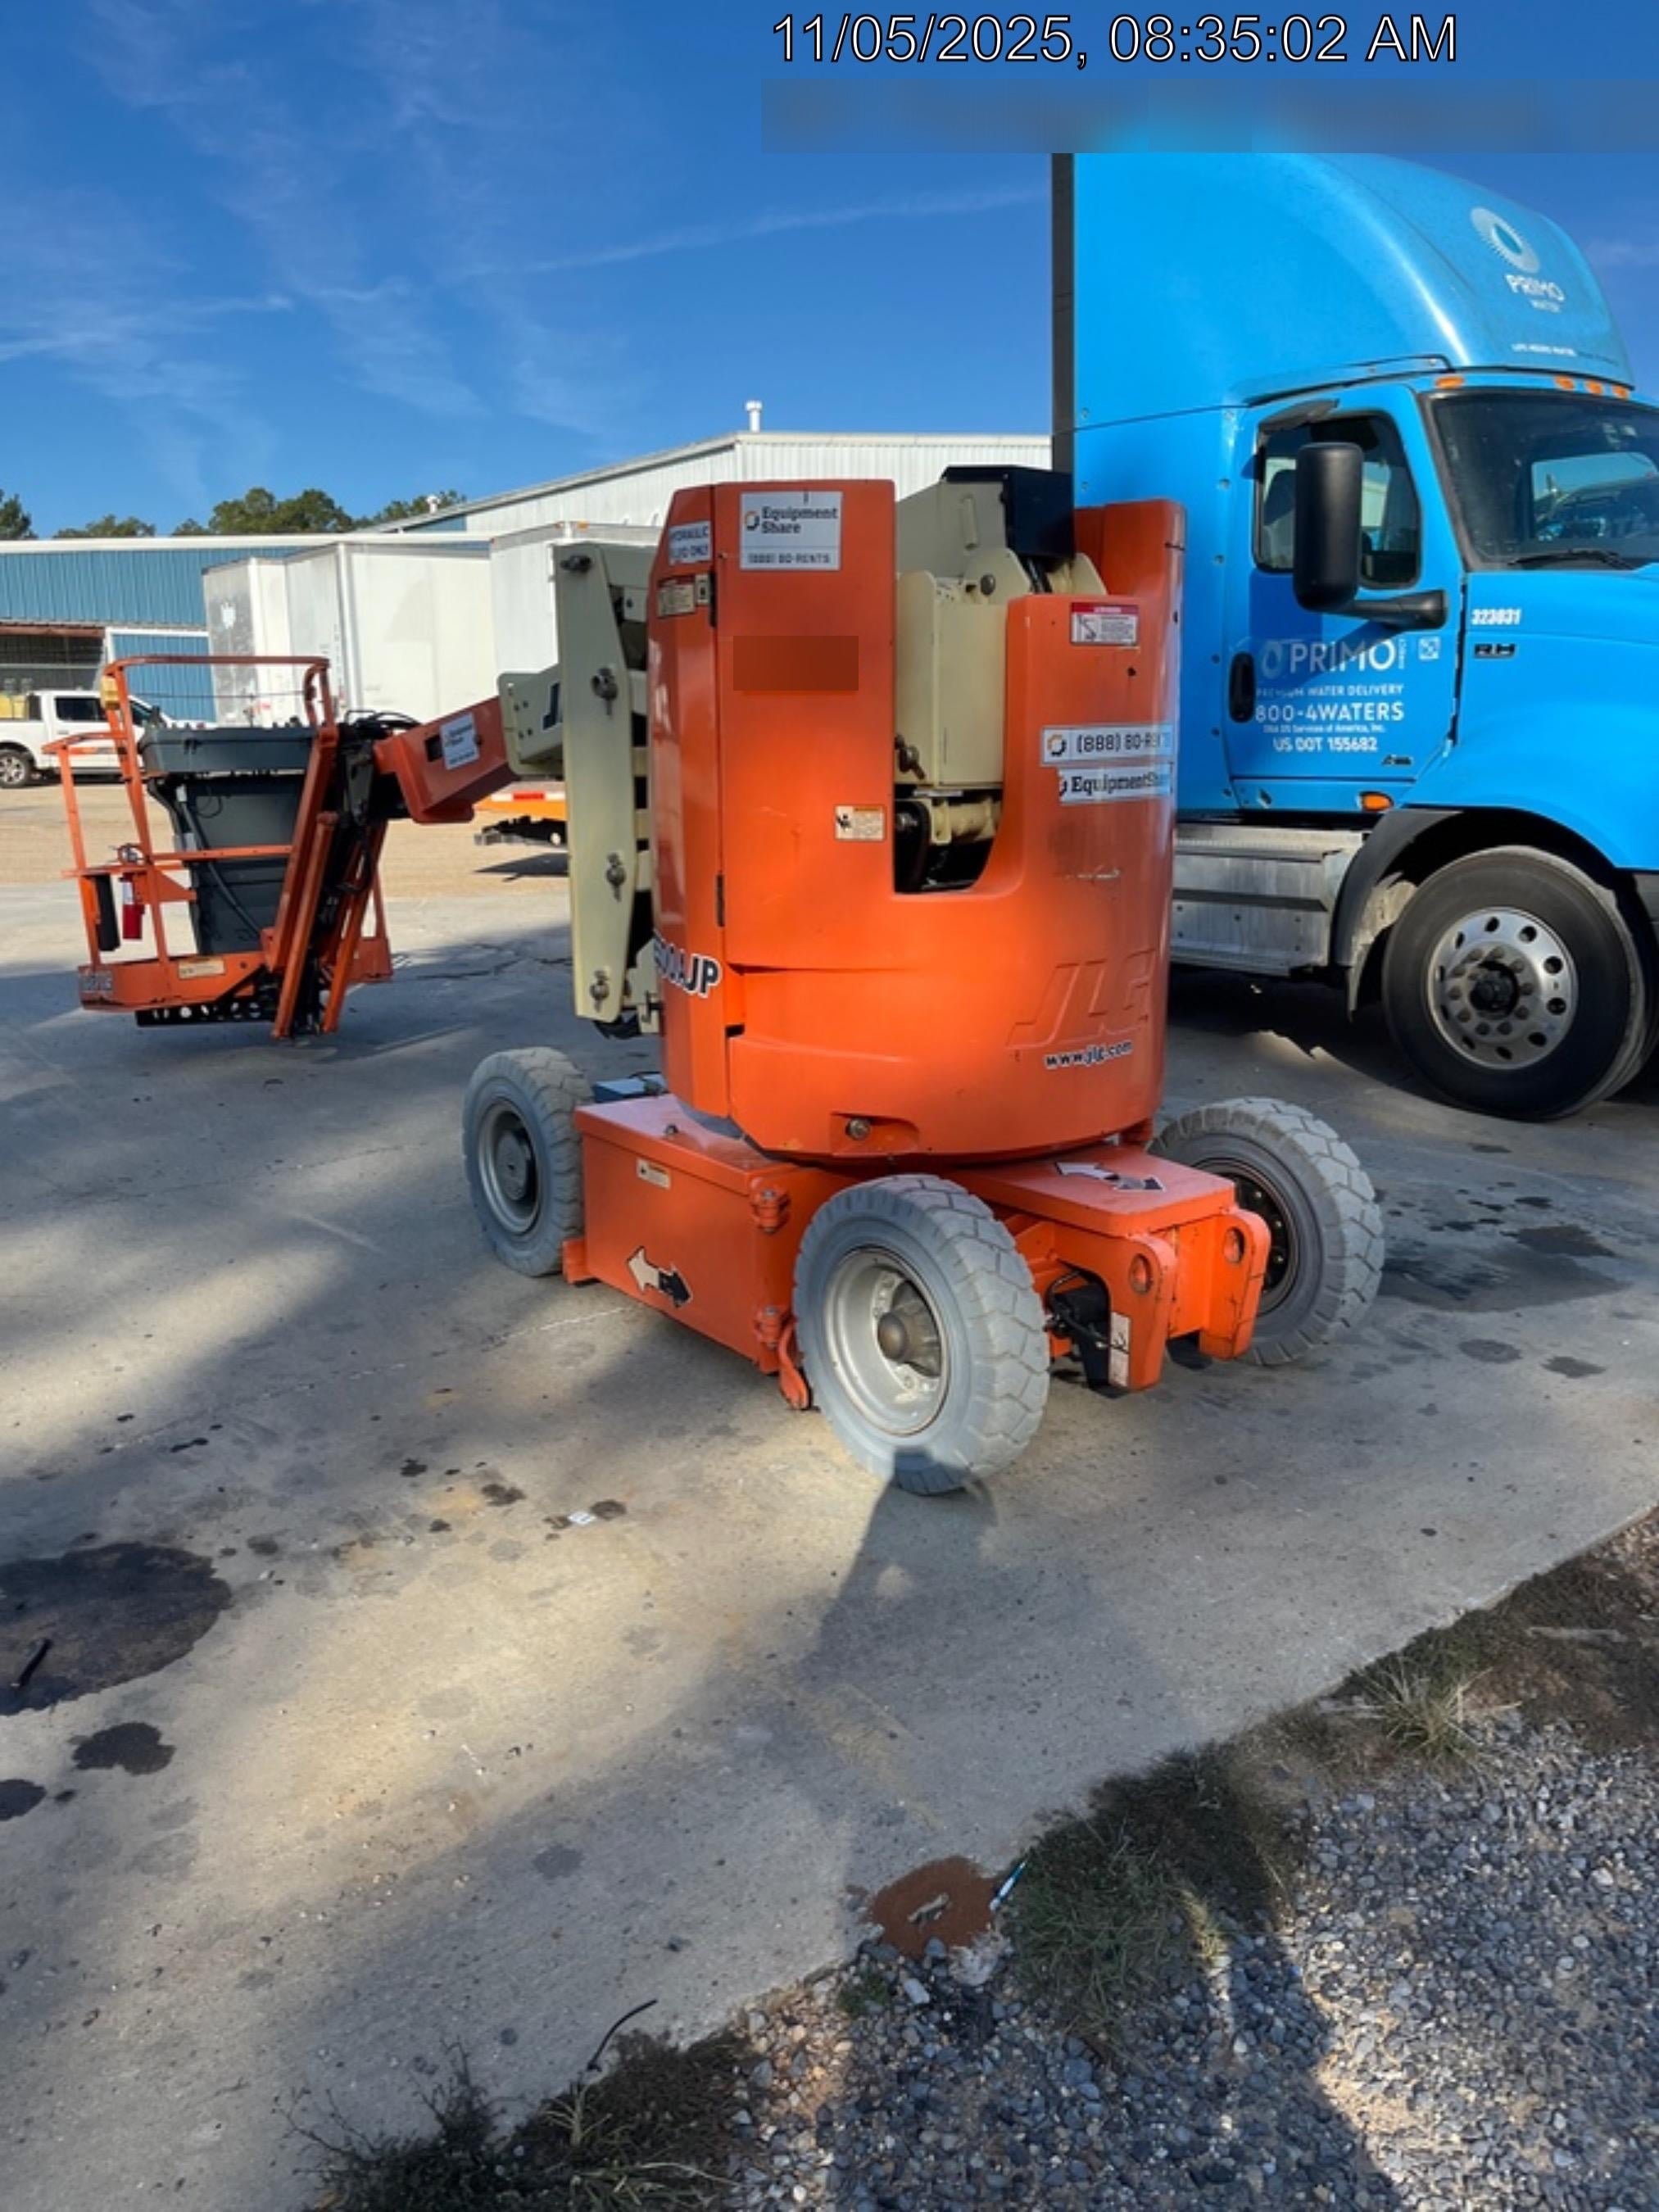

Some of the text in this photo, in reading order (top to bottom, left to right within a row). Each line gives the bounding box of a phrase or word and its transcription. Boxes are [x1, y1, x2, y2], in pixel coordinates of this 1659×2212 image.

[1505, 273, 1566, 302] PRIMO
[762, 506, 839, 521] Equipment
[762, 521, 802, 534] Share
[1289, 638, 1396, 672] PRIMO
[1308, 685, 1344, 696] WATER
[1347, 683, 1404, 696] DELIVERY
[1254, 701, 1405, 723] 800-4WATERS
[1077, 734, 1121, 753] (888)
[1272, 737, 1294, 752] US
[1295, 737, 1324, 752] DOT
[1045, 1040, 1134, 1070] www.jlg.com
